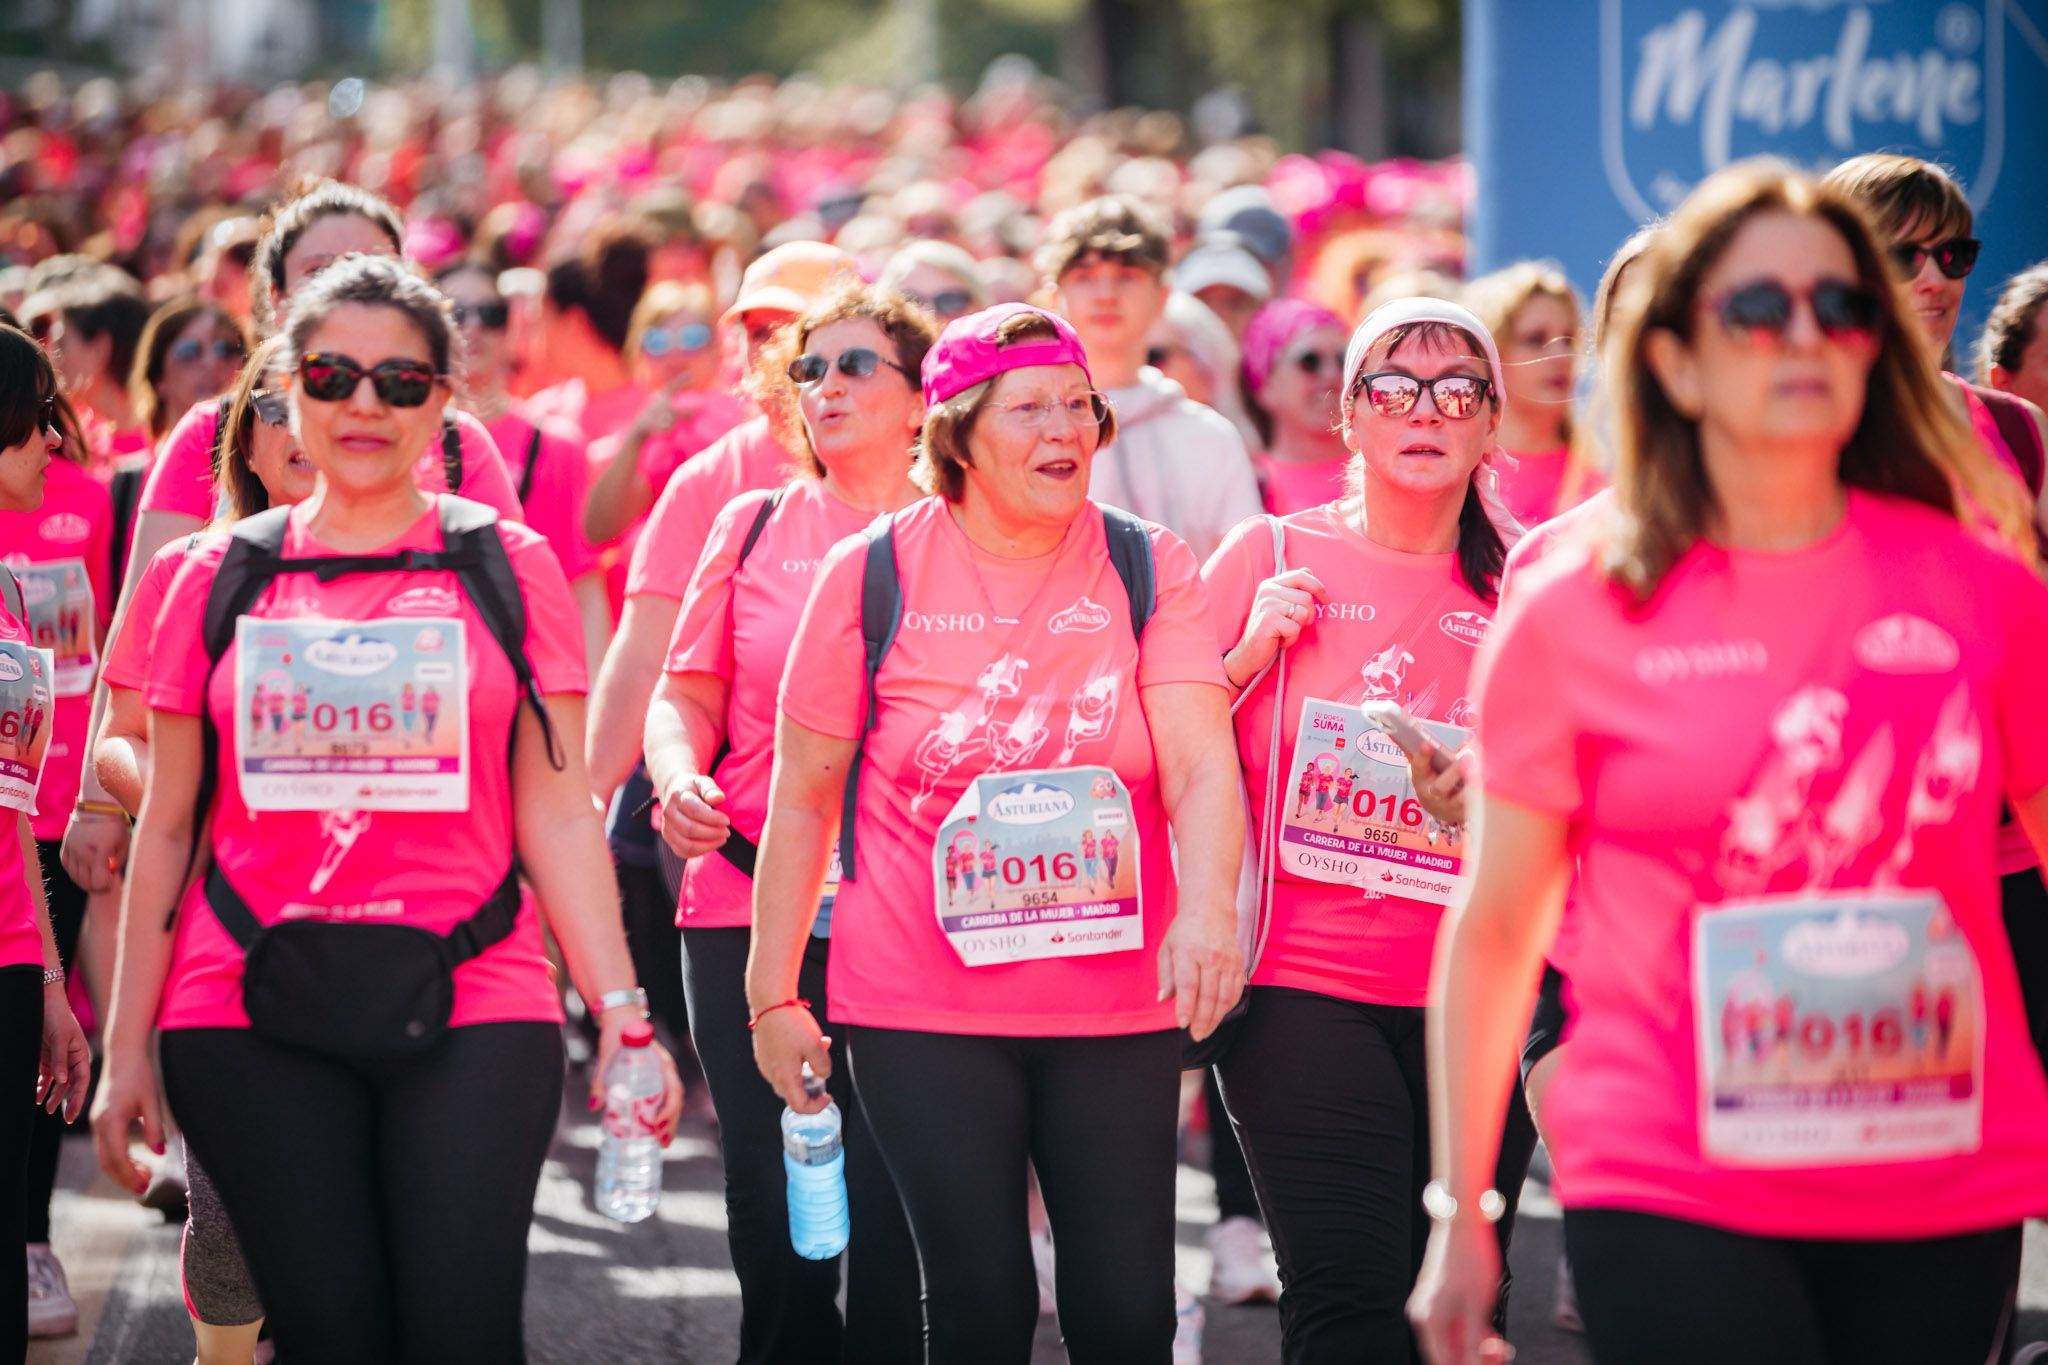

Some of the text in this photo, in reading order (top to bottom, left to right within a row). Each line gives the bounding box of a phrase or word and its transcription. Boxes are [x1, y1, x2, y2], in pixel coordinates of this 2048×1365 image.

[1629, 8, 1981, 172] Marlene
[903, 610, 985, 633] OYSHO
[1313, 602, 1377, 622] YSHO
[313, 702, 395, 733] 016
[1312, 718, 1345, 733] SUMA
[1362, 735, 1403, 757] ASTUR
[993, 799, 1071, 817] ASTURIANA
[1352, 789, 1424, 827] 016
[1363, 827, 1399, 844] 9650
[1303, 831, 1454, 870] CARRERA DE LA MUJER MADRID
[1001, 852, 1078, 886] 016
[1298, 851, 1359, 876] OYSHO
[1395, 873, 1452, 896] Santander
[1022, 891, 1060, 907] 9654
[961, 903, 1121, 929] CARRERA DE LA MUJER MADRID
[962, 933, 1027, 954] OYSHO
[1067, 927, 1124, 944] Santander
